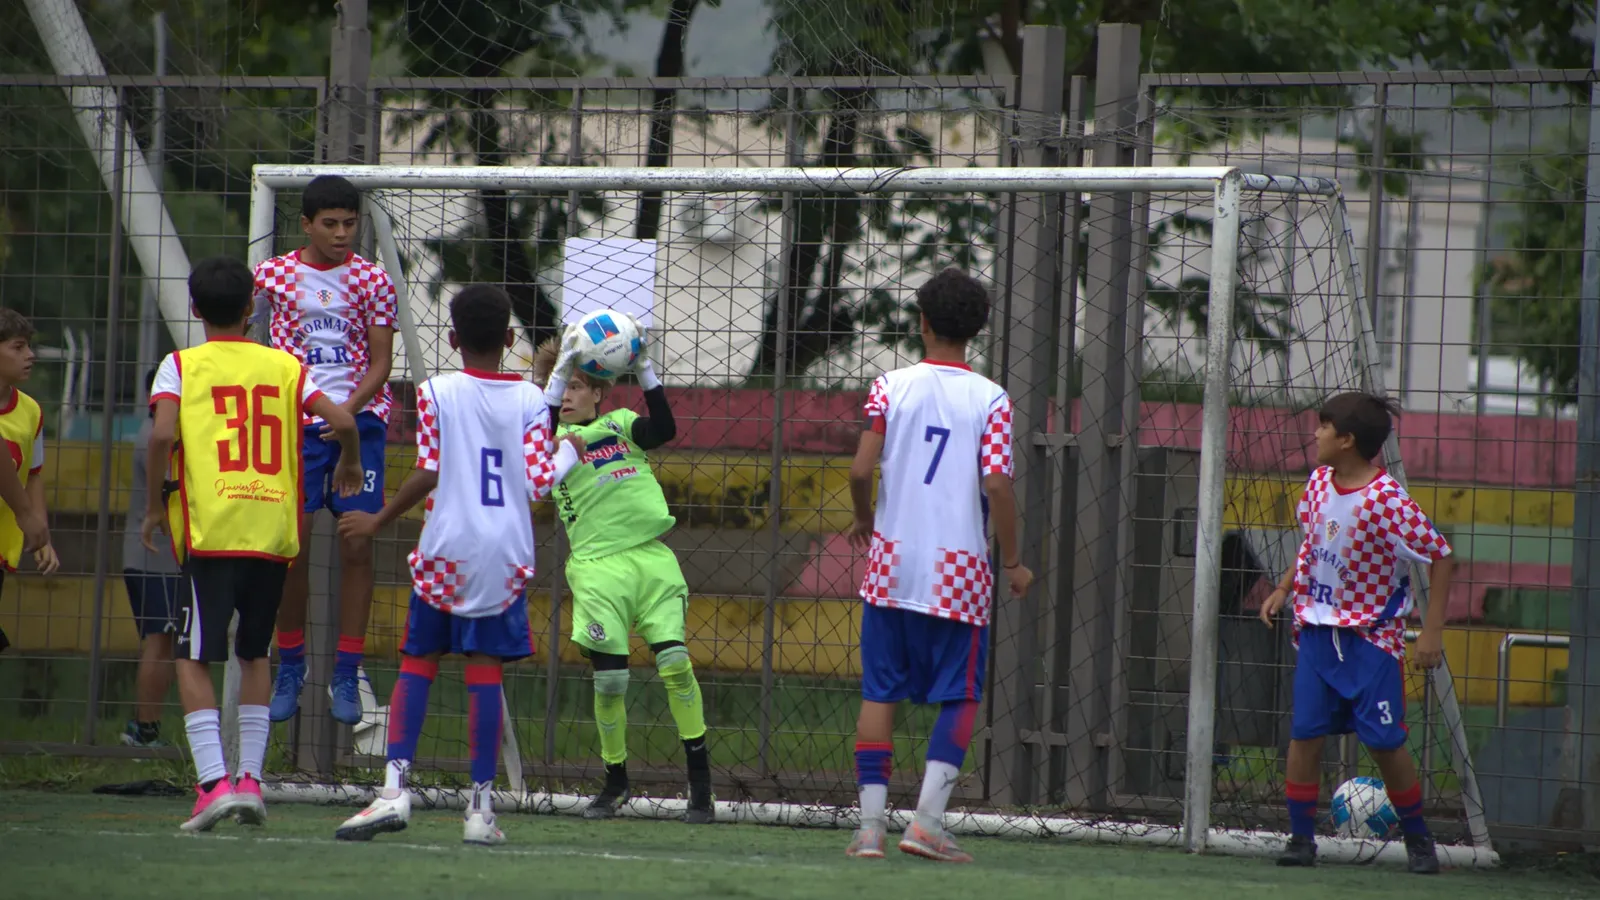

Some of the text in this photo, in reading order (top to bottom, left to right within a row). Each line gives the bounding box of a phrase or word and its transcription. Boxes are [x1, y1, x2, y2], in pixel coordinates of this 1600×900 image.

[306, 345, 355, 365] H.R.
[211, 384, 282, 475] 36
[923, 425, 951, 485] 7
[214, 478, 251, 497] Javier
[363, 469, 376, 493] 3
[481, 446, 505, 507] 6
[1377, 700, 1393, 725] 3
